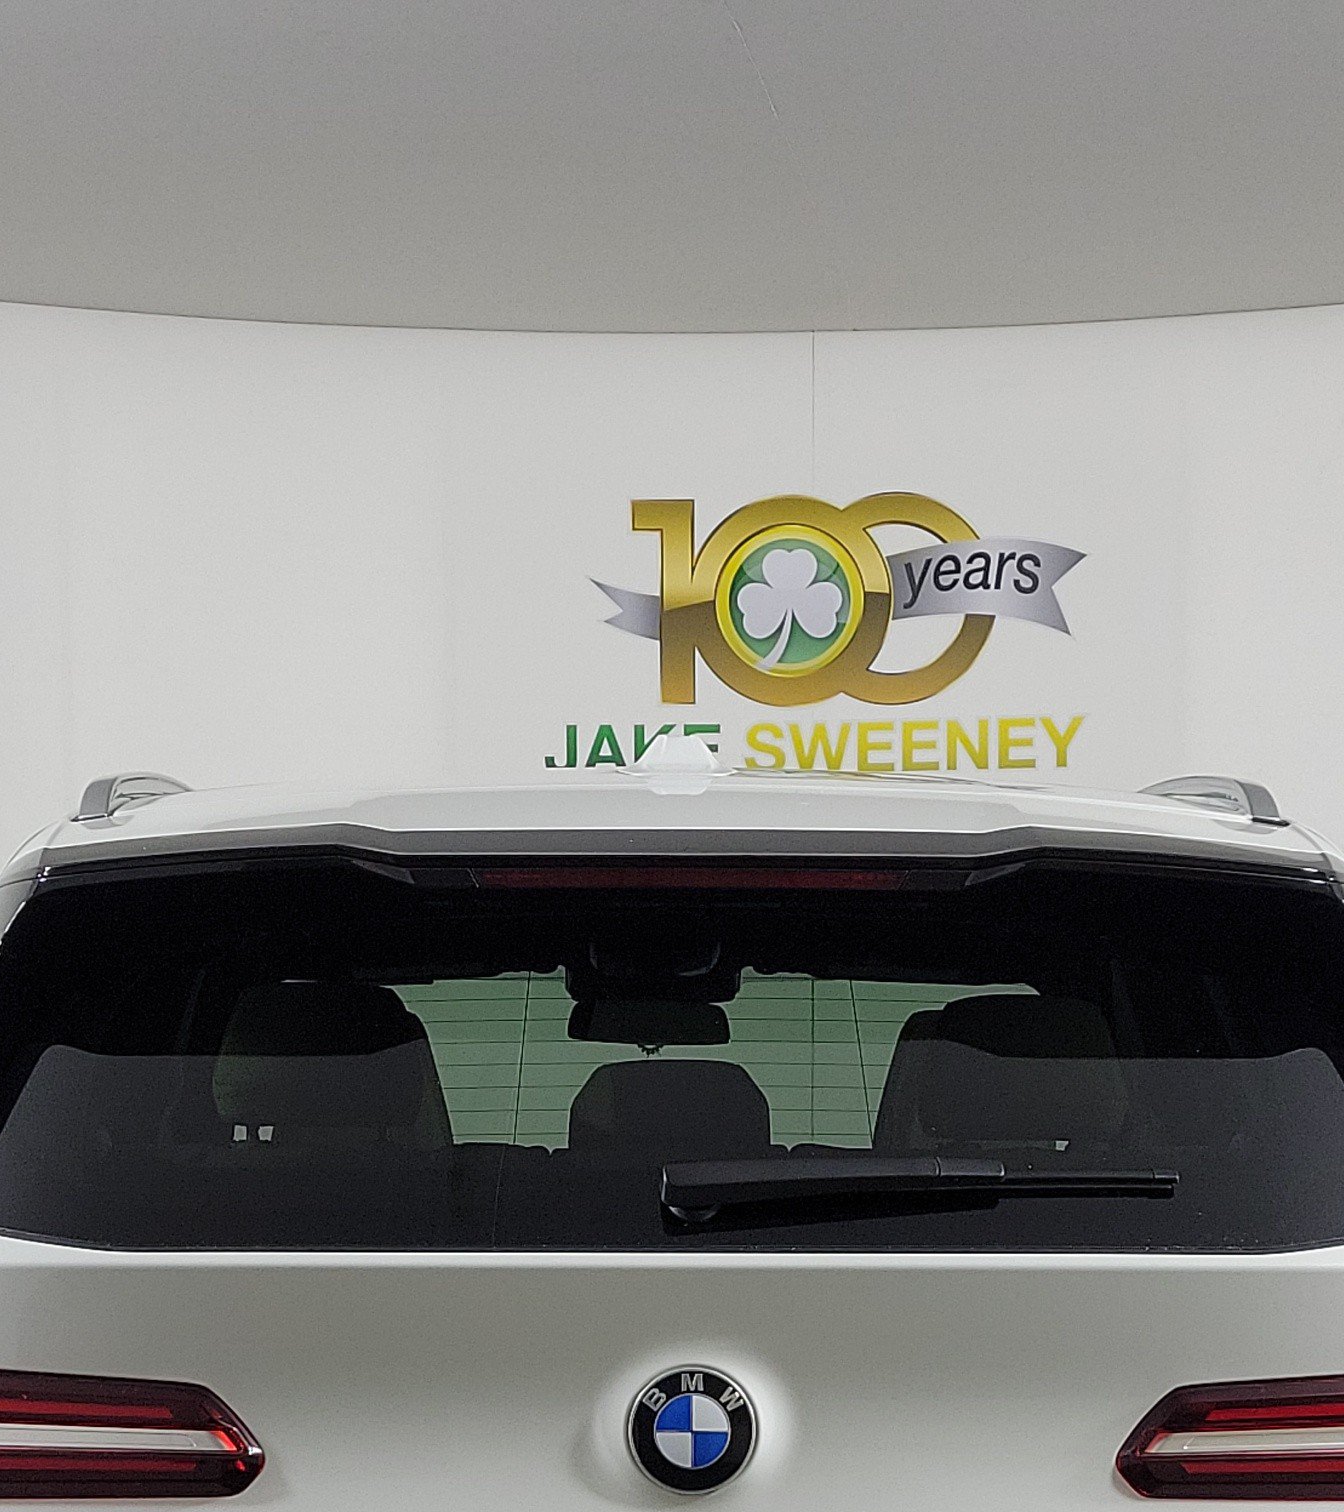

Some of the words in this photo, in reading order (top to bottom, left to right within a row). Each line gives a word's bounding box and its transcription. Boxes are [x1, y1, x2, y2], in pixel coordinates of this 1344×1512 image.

[631, 491, 996, 707] 100
[904, 549, 1043, 608] years
[744, 715, 1086, 772] SWEENEY
[642, 1373, 745, 1413] BMW
